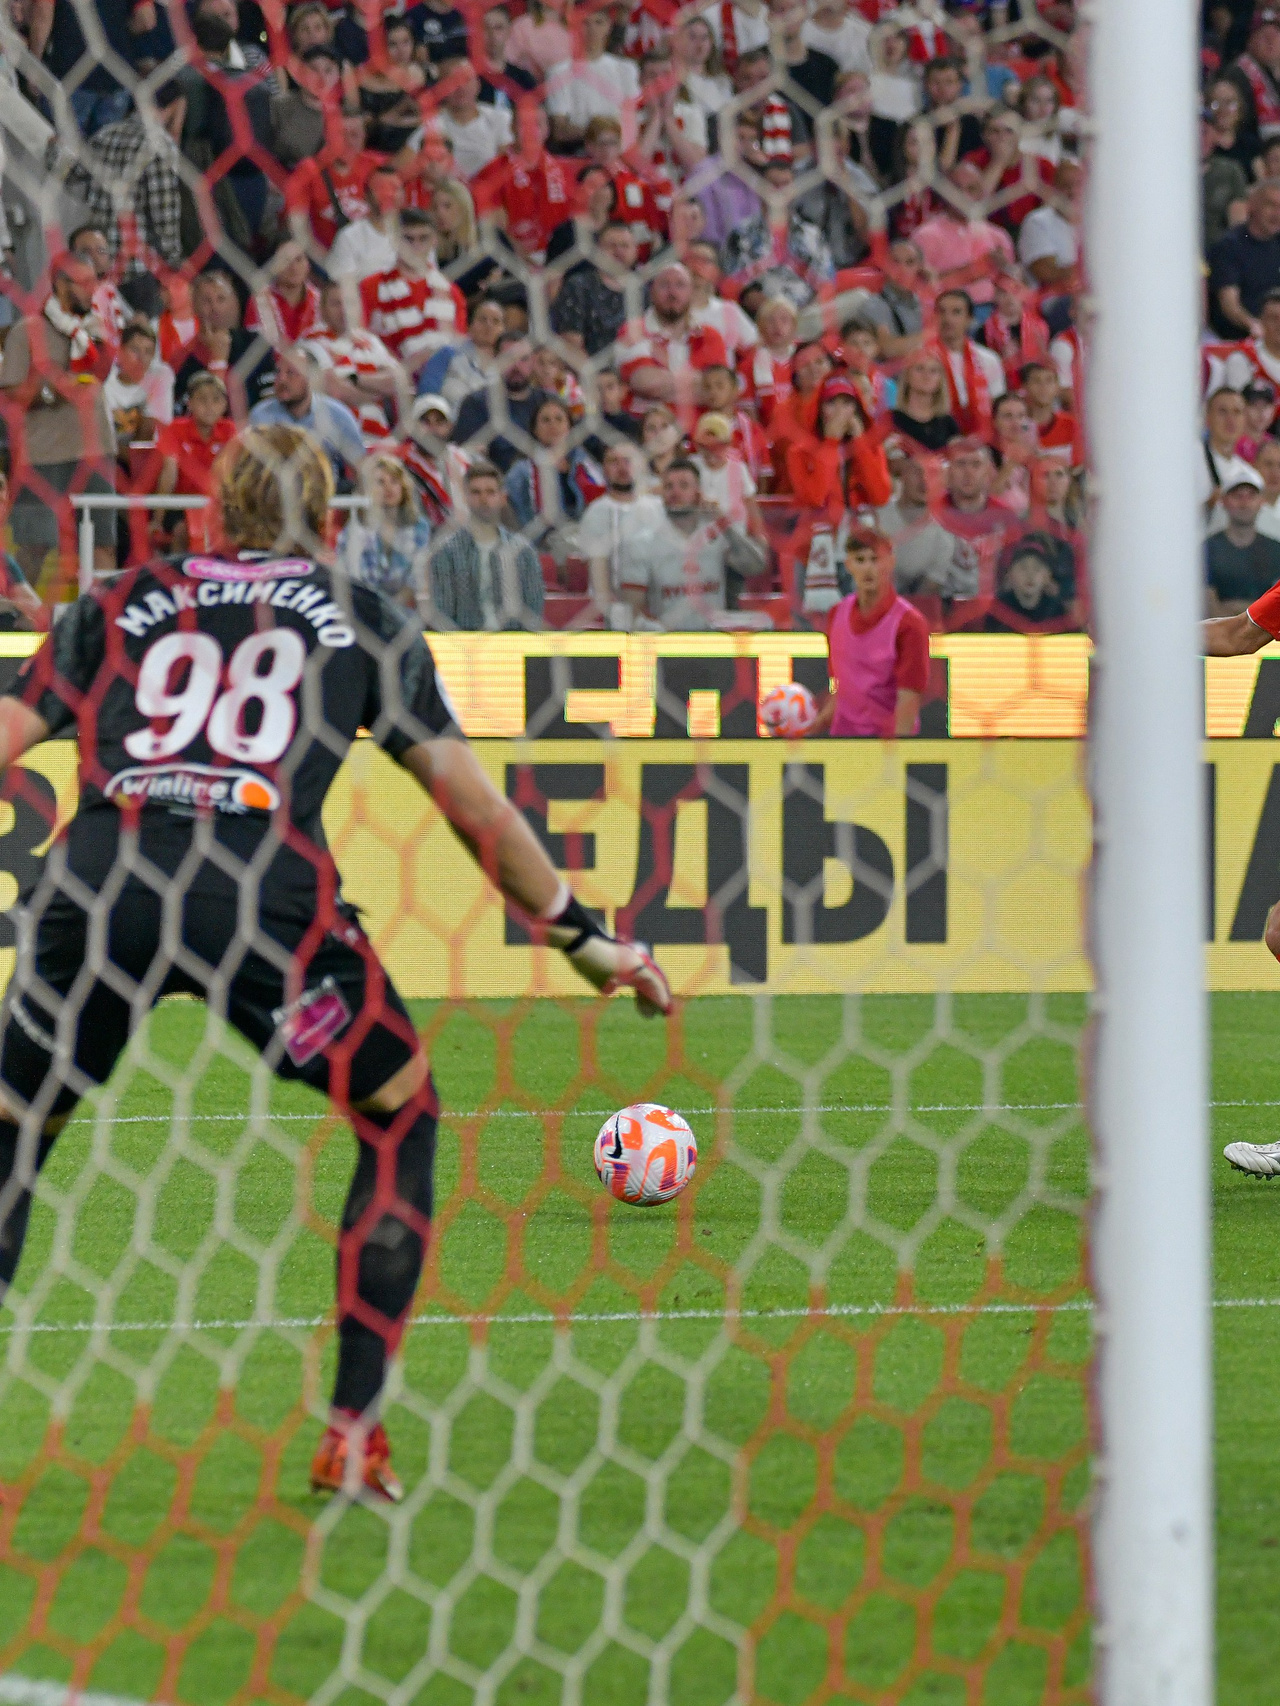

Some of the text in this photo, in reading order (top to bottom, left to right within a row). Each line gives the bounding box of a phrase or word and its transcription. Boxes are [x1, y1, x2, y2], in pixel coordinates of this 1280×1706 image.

[114, 579, 356, 648] МАКСИМЕНКО
[124, 627, 306, 764] 98
[501, 762, 948, 983] ЕДЫ
